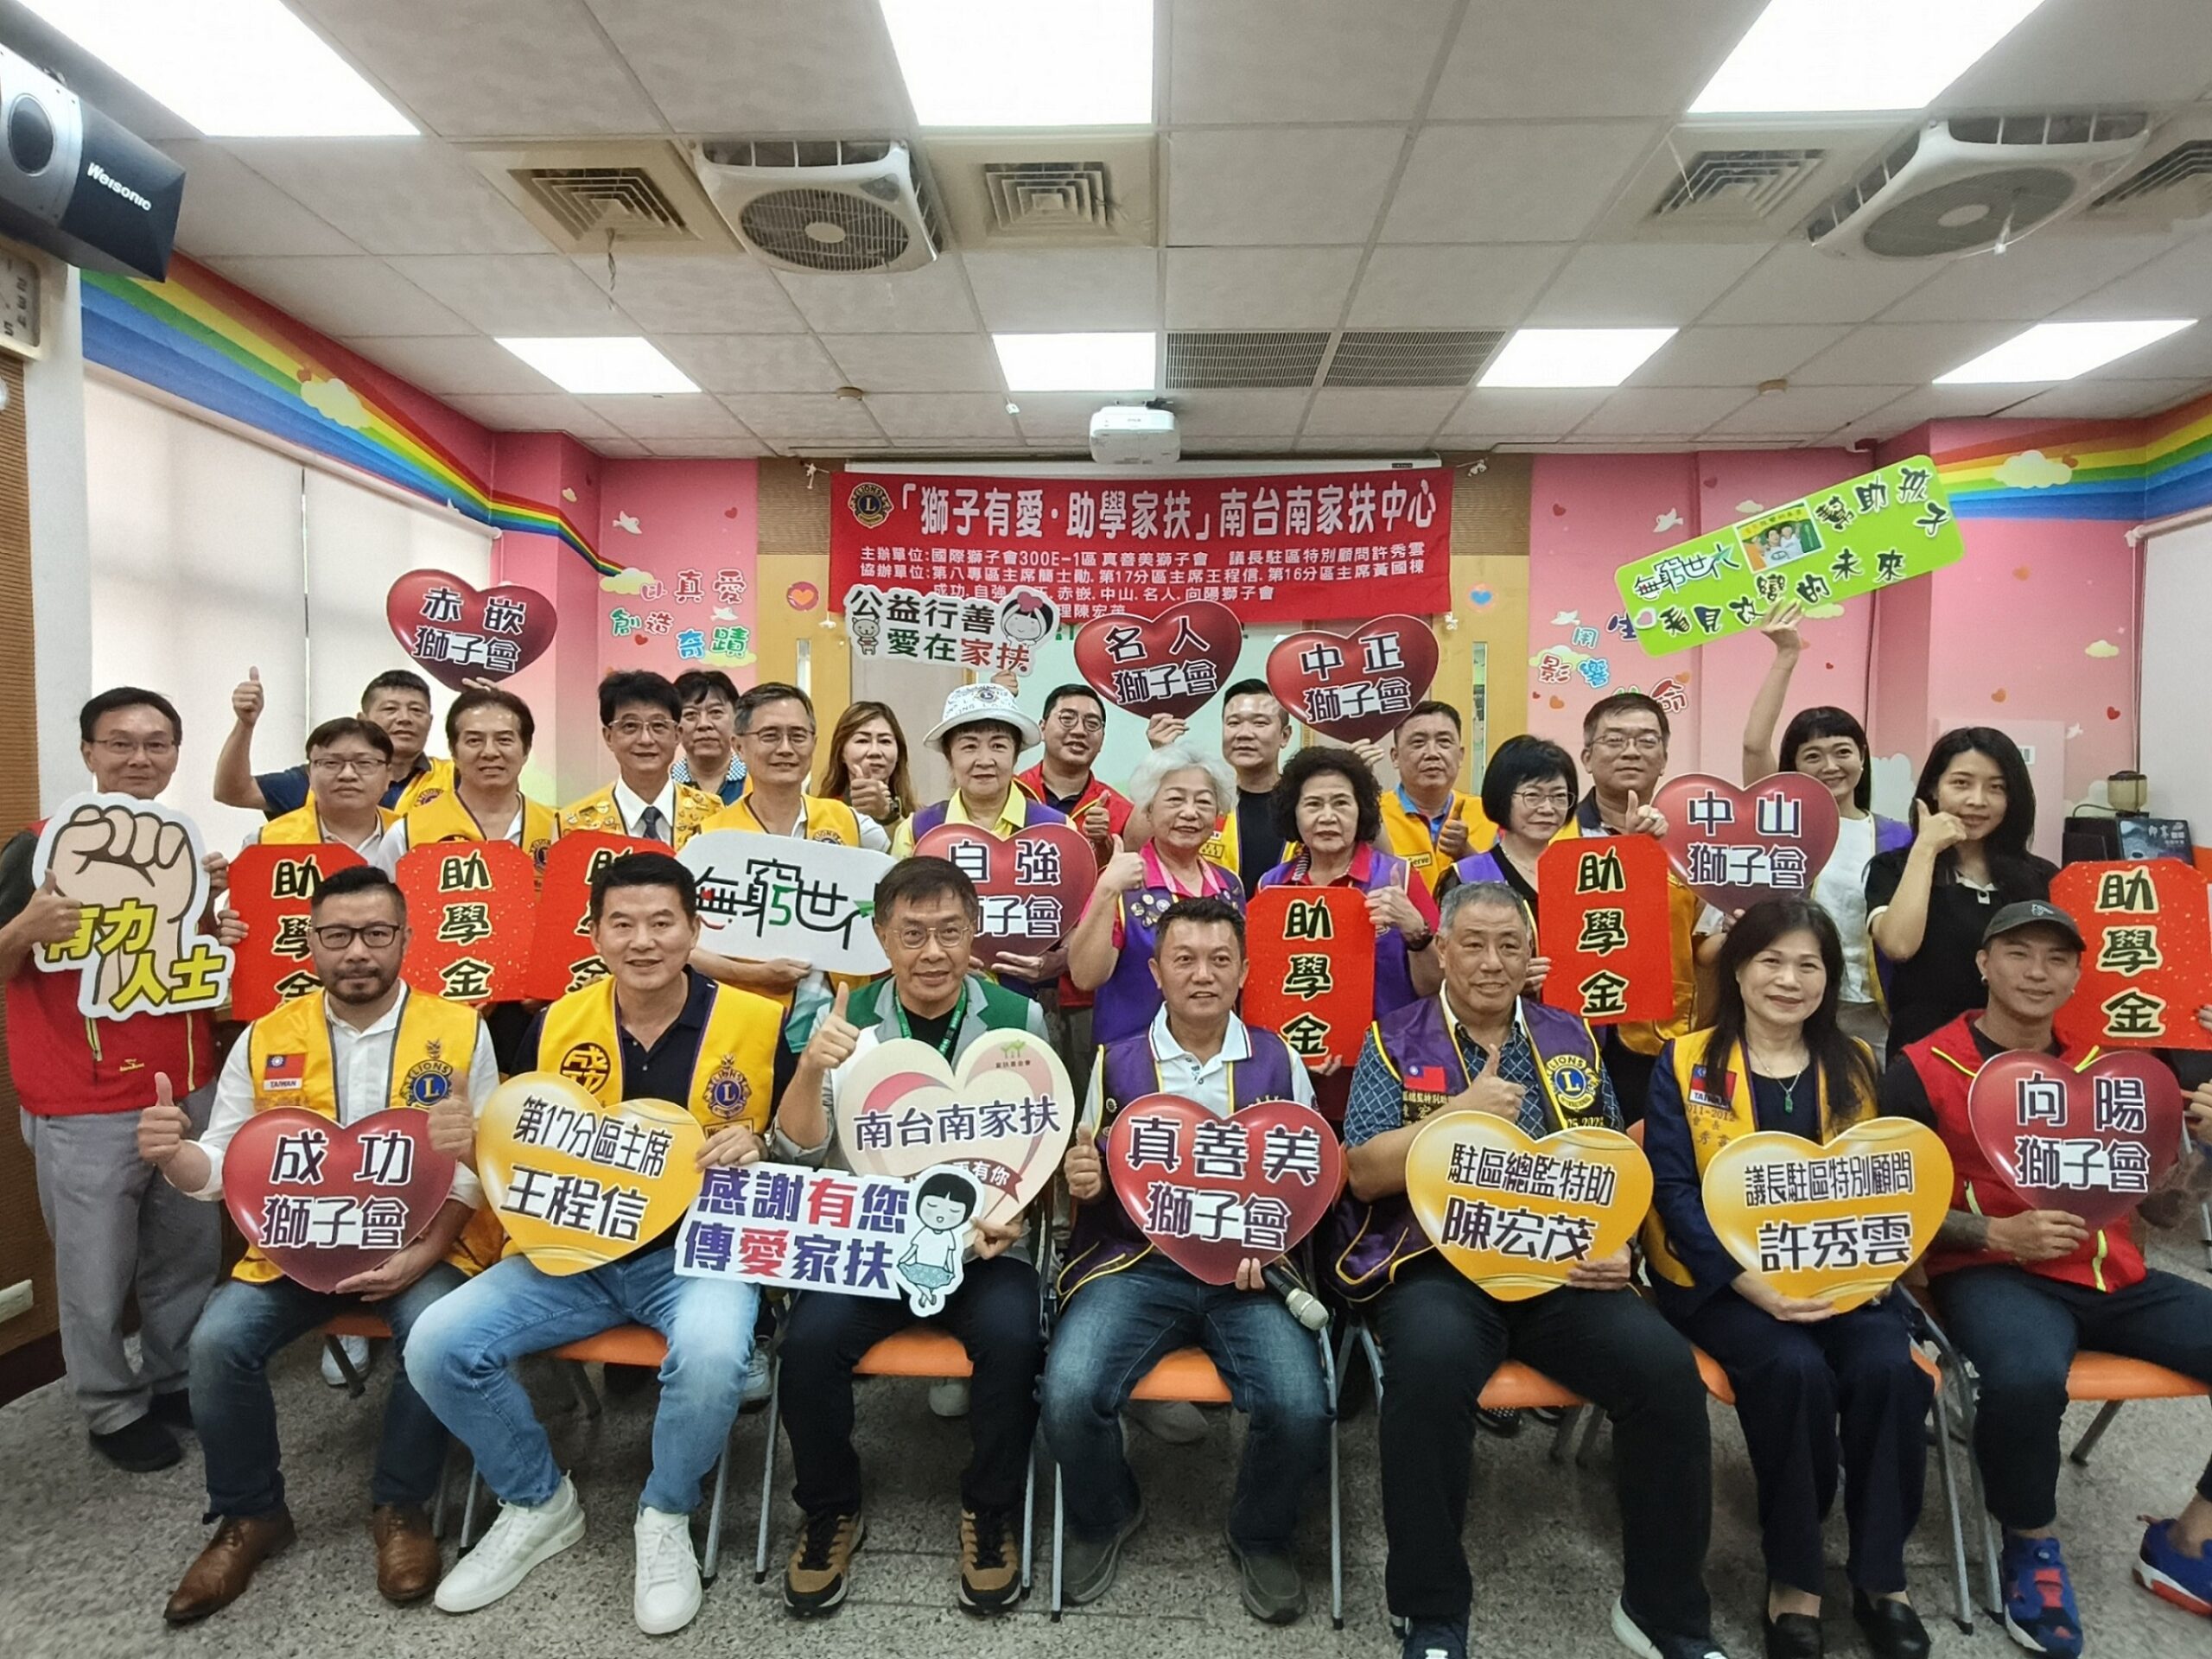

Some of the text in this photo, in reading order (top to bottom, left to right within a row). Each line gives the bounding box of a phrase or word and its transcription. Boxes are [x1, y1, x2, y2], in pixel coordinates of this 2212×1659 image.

[87, 162, 152, 211] Weisonic
[423, 586, 527, 634] 赤嵌
[611, 608, 674, 637] 創造
[850, 589, 996, 635] 公益行善
[413, 626, 521, 672] 獅子會
[675, 626, 749, 659] 奇蹟
[887, 627, 1030, 672] 愛在家扶
[1105, 616, 1211, 664] 名人
[1302, 632, 1404, 680] 中正
[1113, 660, 1217, 705] 獅子會
[1541, 655, 1608, 688] 影響
[1304, 678, 1410, 723] 獅子會
[1688, 790, 1802, 839] 中山
[950, 840, 1061, 886] 自強
[1688, 842, 1807, 889] 獅子會
[438, 850, 493, 1001] 助學金
[977, 895, 1064, 938] 子會
[1576, 847, 1630, 1017] 助學金
[1281, 896, 1333, 1057] 助學金
[2096, 867, 2167, 1038] 助學金
[412, 1062, 448, 1076] LIONS
[423, 1077, 439, 1098] L
[1548, 1056, 1584, 1070] LIONS
[1561, 1071, 1581, 1091] L
[722, 1083, 736, 1102] L
[2015, 1071, 2147, 1133] 向陽
[513, 1095, 674, 1179] 第17分區主席
[854, 1094, 1061, 1153] 南台南家扶
[270, 1129, 415, 1185] 成功
[1127, 1116, 1322, 1186] 真善美
[1448, 1142, 1618, 1207] 駐區總監特助
[2014, 1135, 2148, 1194] 獅子會
[500, 1163, 650, 1242] 王程信
[697, 1167, 910, 1234] 感謝有您
[1744, 1149, 1915, 1208] 議長駐區特別顧問
[259, 1194, 409, 1250] 獅子會
[1147, 1181, 1291, 1252] 獅子會
[1441, 1198, 1597, 1263] 陳宏茂
[683, 1220, 897, 1290] 傳愛家扶
[1758, 1214, 1912, 1274] 許秀雲
